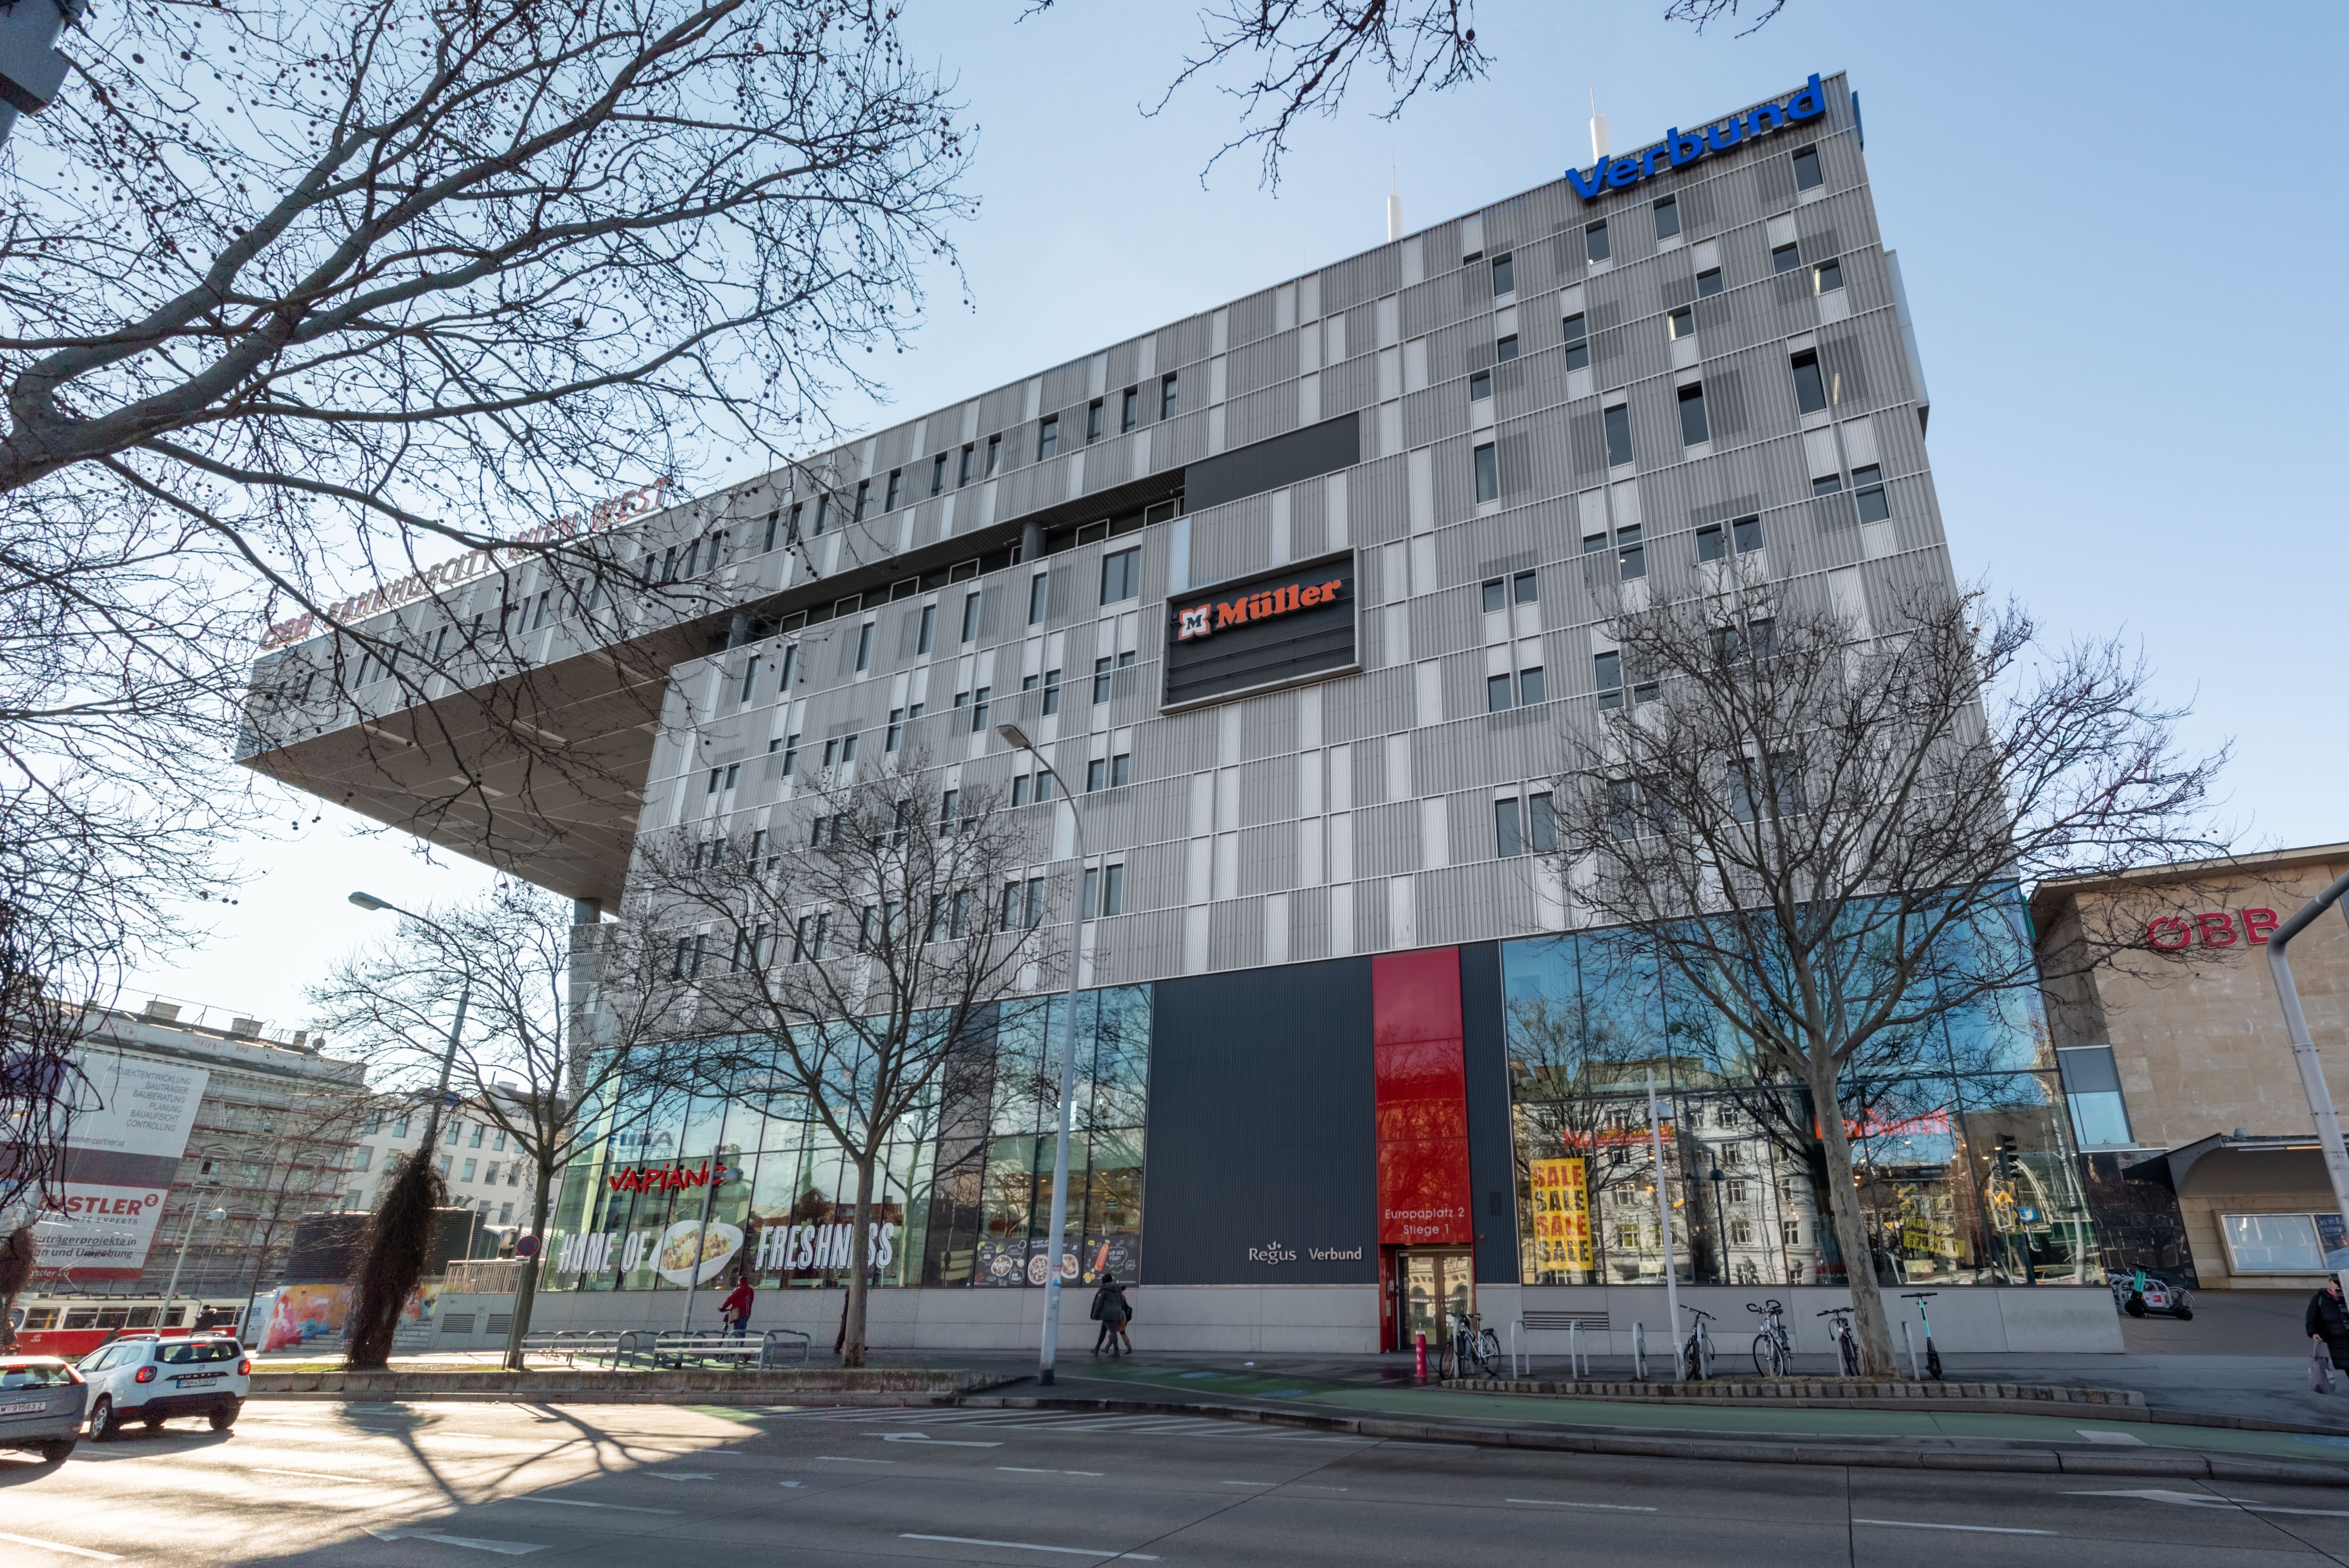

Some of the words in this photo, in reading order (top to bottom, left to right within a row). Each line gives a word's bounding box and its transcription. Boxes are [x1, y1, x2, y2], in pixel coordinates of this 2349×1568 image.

[1565, 72, 1825, 202] Verbund
[592, 476, 670, 531] WEST
[1216, 580, 1341, 628] Müller
[107, 1066, 192, 1085] PROJEKTENTWICKLUNG
[133, 1090, 185, 1103] BAUBERATUNG
[145, 1082, 188, 1094] BAUTRÄGER
[130, 1109, 179, 1122] BAUAUFSICHT
[149, 1102, 182, 1113] PLANUNG
[126, 1119, 176, 1132] CONTROLLING
[1534, 1165, 1583, 1187] SALE
[1535, 1190, 1585, 1212] SALE
[1385, 1208, 1453, 1220] Europaplatz
[1458, 1207, 1464, 1217] 2
[1404, 1225, 1439, 1236] Stiege
[1445, 1224, 1449, 1233] 1
[1536, 1215, 1587, 1237] SALE
[51, 1248, 74, 1257] und
[76, 1248, 133, 1259] Umgebung
[557, 1232, 617, 1273] HOME
[621, 1231, 651, 1273] OF
[755, 1222, 894, 1271] FRESHNSS
[1308, 1247, 1362, 1260] Verbund
[1538, 1240, 1590, 1262] SALE
[1249, 1248, 1297, 1265] Regus
